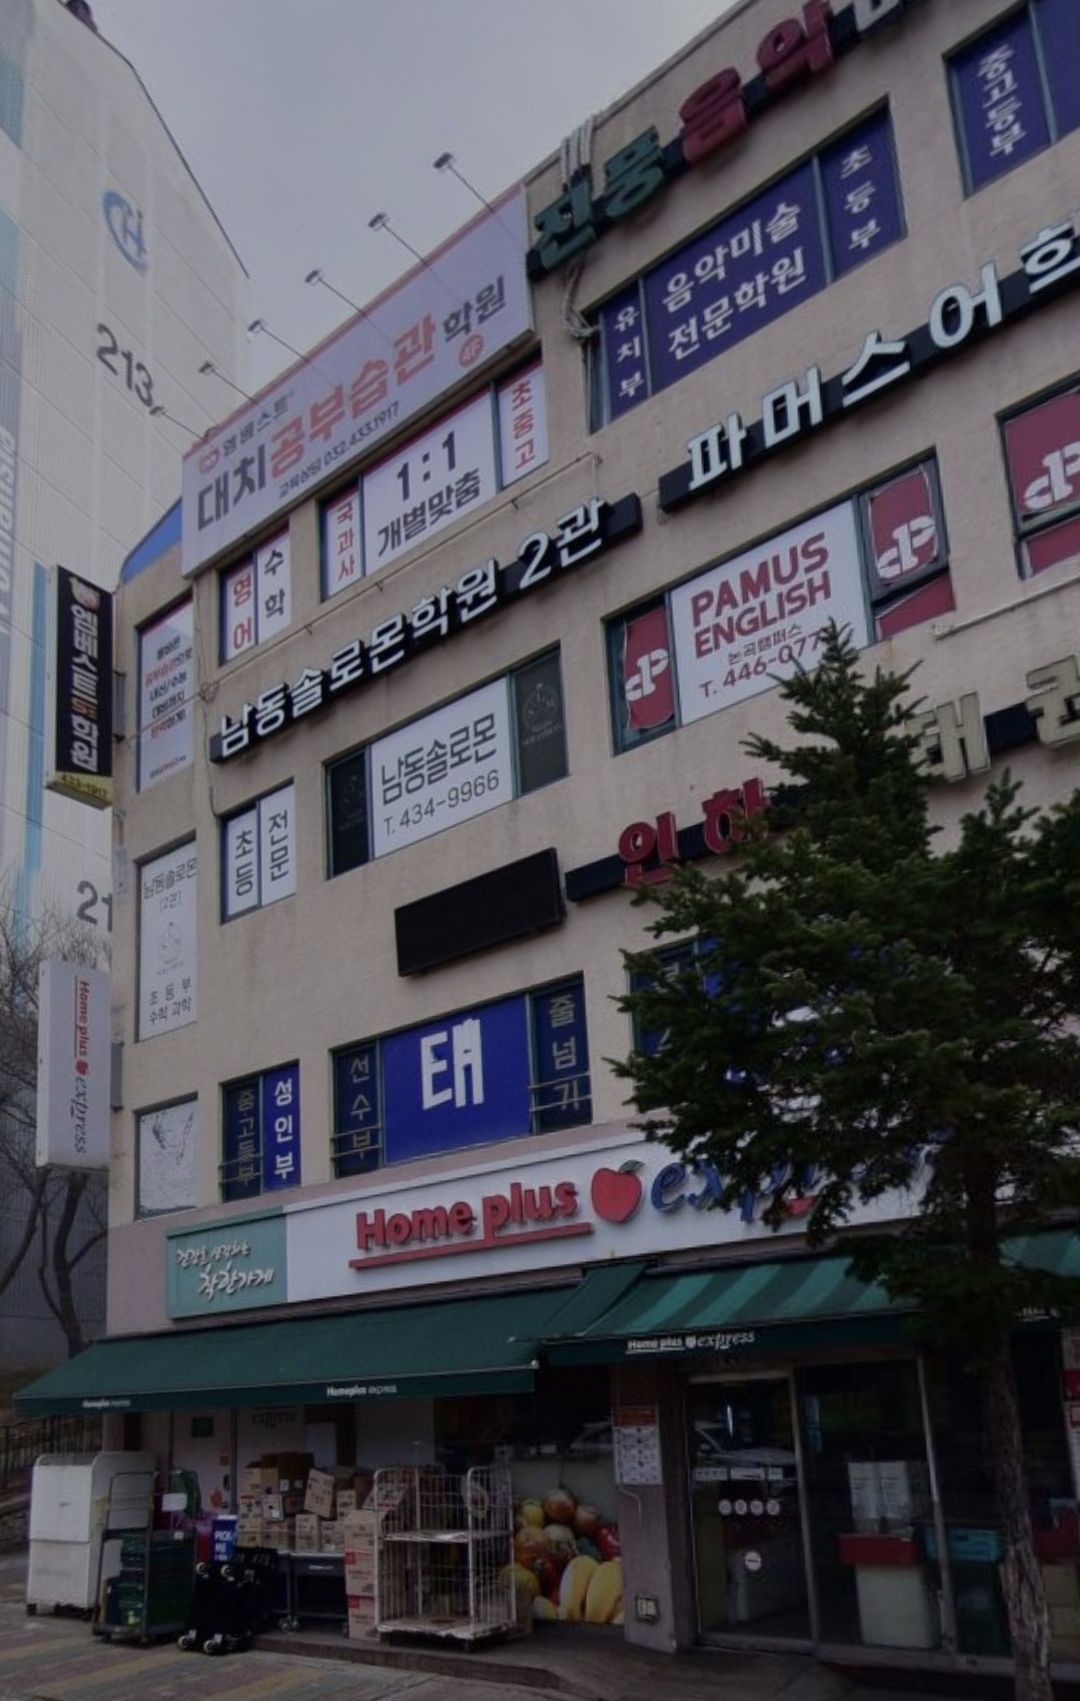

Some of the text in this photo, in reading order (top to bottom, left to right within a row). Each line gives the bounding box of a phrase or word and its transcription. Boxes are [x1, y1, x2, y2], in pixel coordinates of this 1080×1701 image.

[841, 145, 881, 250] 초등부
[661, 202, 802, 314] 음악미술
[669, 248, 807, 362] 전문학원
[613, 305, 644, 398] 유치부
[512, 381, 536, 471] 초중고
[337, 496, 356, 579] 국과사
[378, 468, 481, 558] 개별맞춤
[233, 573, 252, 651] 영어
[264, 548, 285, 619] 수학
[690, 532, 828, 627] PAMUS
[695, 570, 831, 659] ENGLISH
[221, 558, 499, 758] 남동솔로몬학원
[380, 712, 497, 806] 남동솔로몬
[234, 830, 254, 897] 초등
[268, 810, 289, 882] 전문
[274, 1078, 295, 1180] 성인부
[350, 1054, 372, 1160] 선수부
[356, 1182, 578, 1250] Home plus
